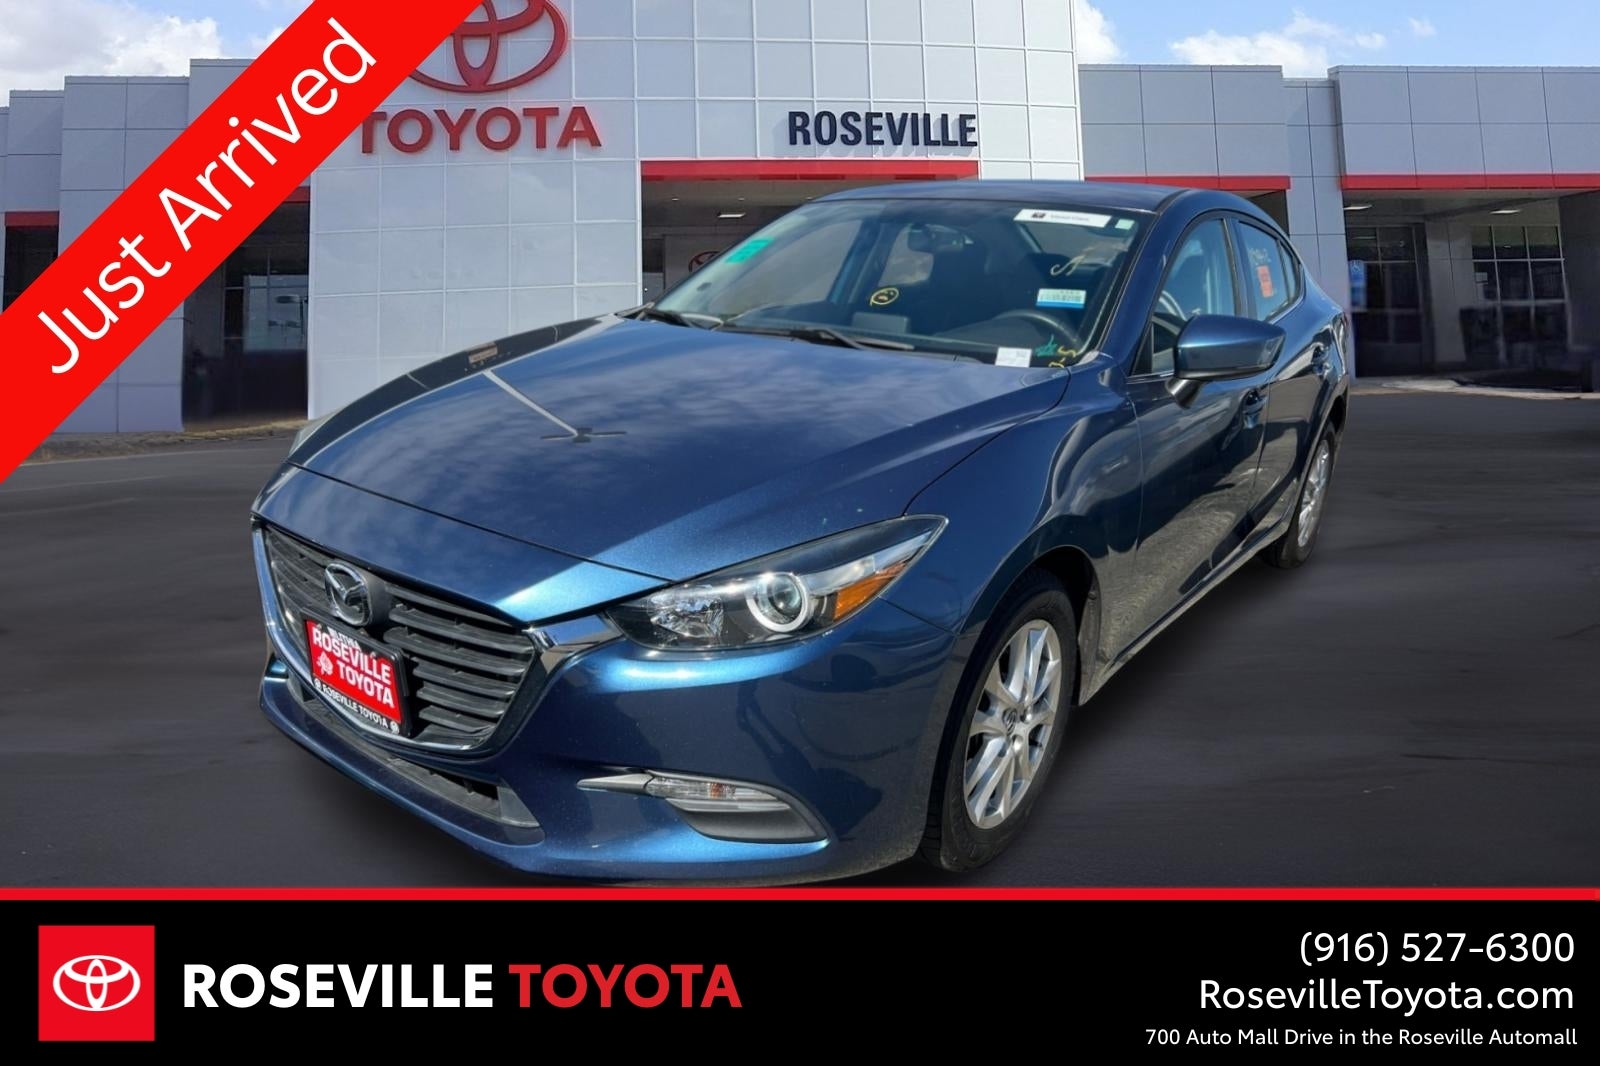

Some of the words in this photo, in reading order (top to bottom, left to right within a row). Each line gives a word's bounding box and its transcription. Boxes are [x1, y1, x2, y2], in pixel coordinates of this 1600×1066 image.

[361, 106, 602, 154] TOYOTA
[788, 110, 978, 147] ROSEVILLE
[312, 626, 392, 686] ROSEVILLE
[322, 684, 360, 713] ROSEVILLE
[358, 705, 389, 729] TOYOTA
[336, 660, 395, 709] TOYOTA
